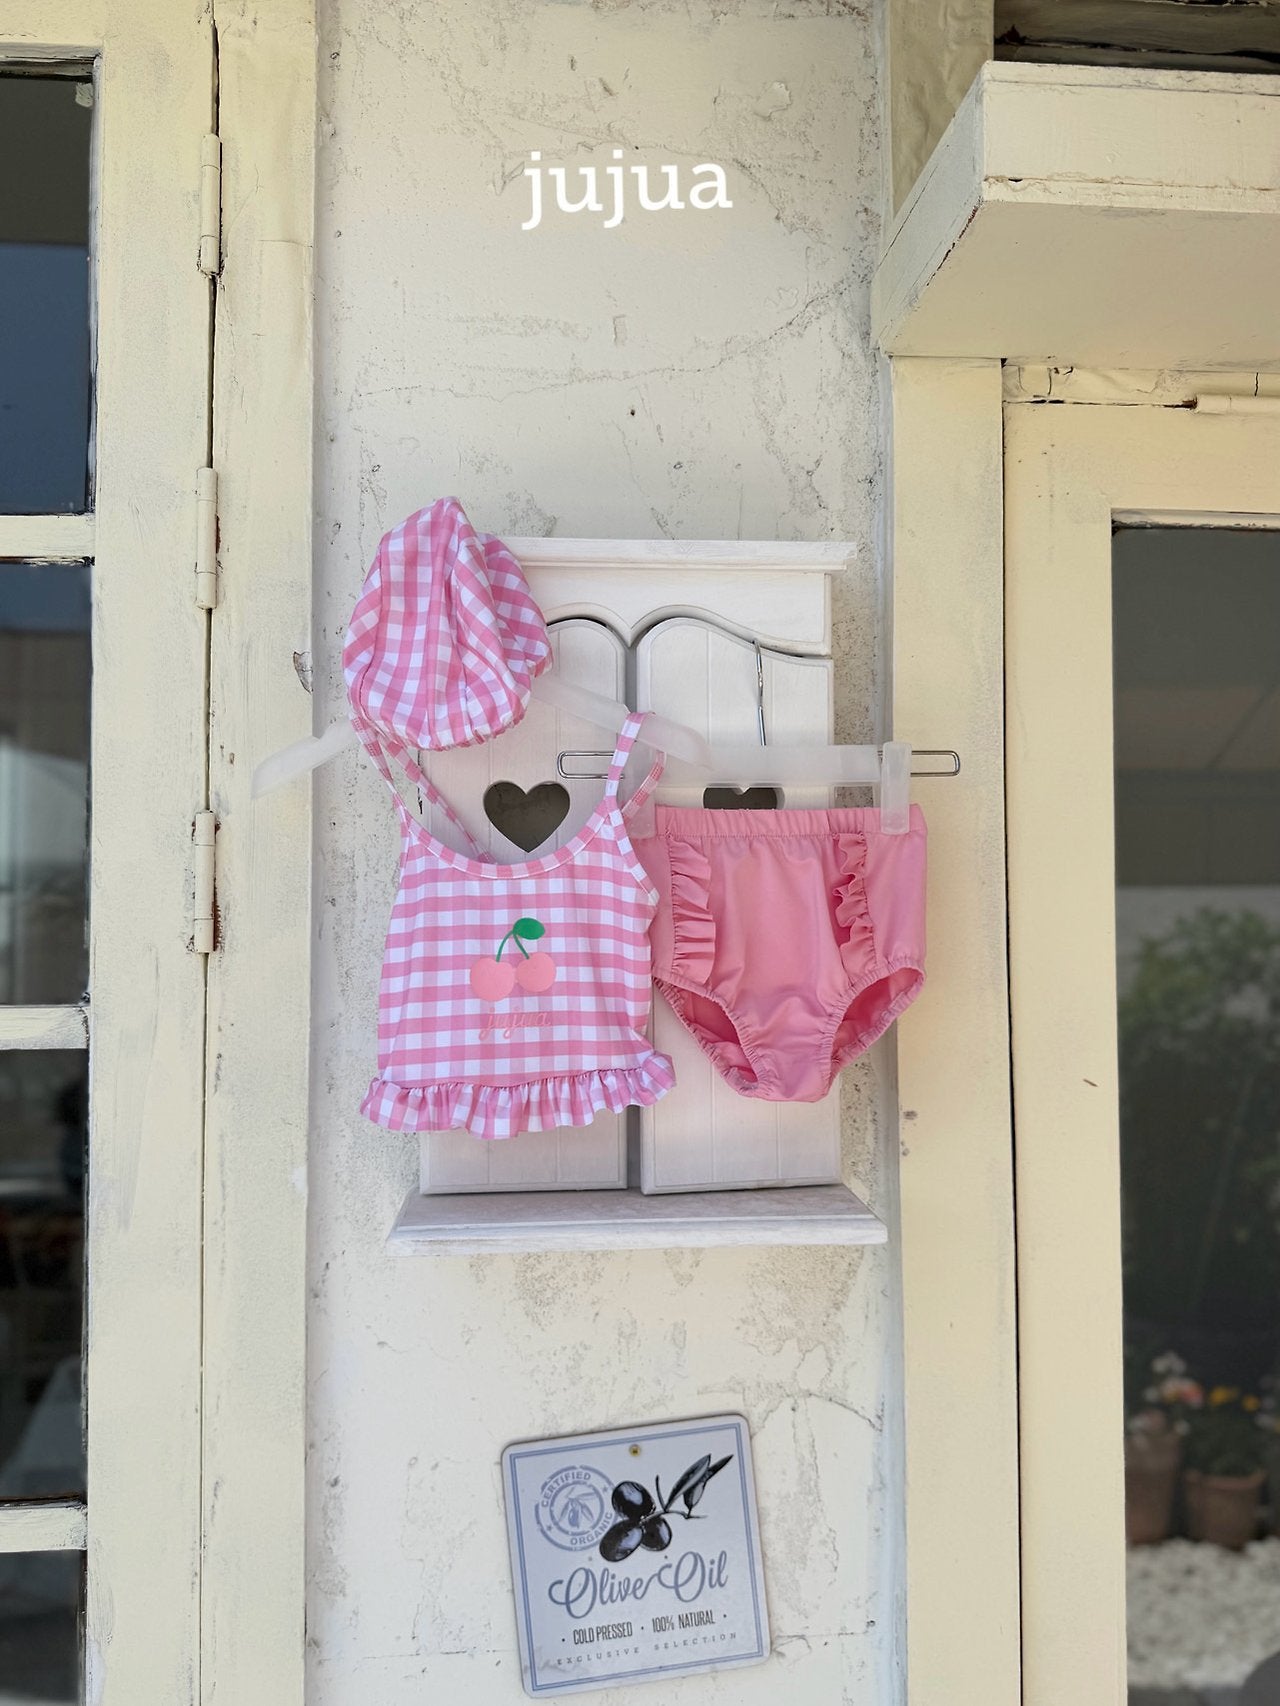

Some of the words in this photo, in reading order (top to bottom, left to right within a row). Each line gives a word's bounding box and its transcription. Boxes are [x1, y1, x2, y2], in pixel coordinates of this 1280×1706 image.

[478, 1007, 552, 1041] jujua
[541, 1471, 591, 1507] CERTIFIED
[570, 1512, 613, 1545] ORGANIC
[549, 1567, 656, 1619] Olive
[657, 1550, 729, 1602] Oil
[573, 1627, 595, 1645] COLD
[596, 1622, 633, 1642] PRESSED
[652, 1615, 675, 1633] 100%
[678, 1610, 716, 1629] NATURAL
[557, 1647, 640, 1666] EXCLUSIVE
[654, 1632, 737, 1651] SELECTION
